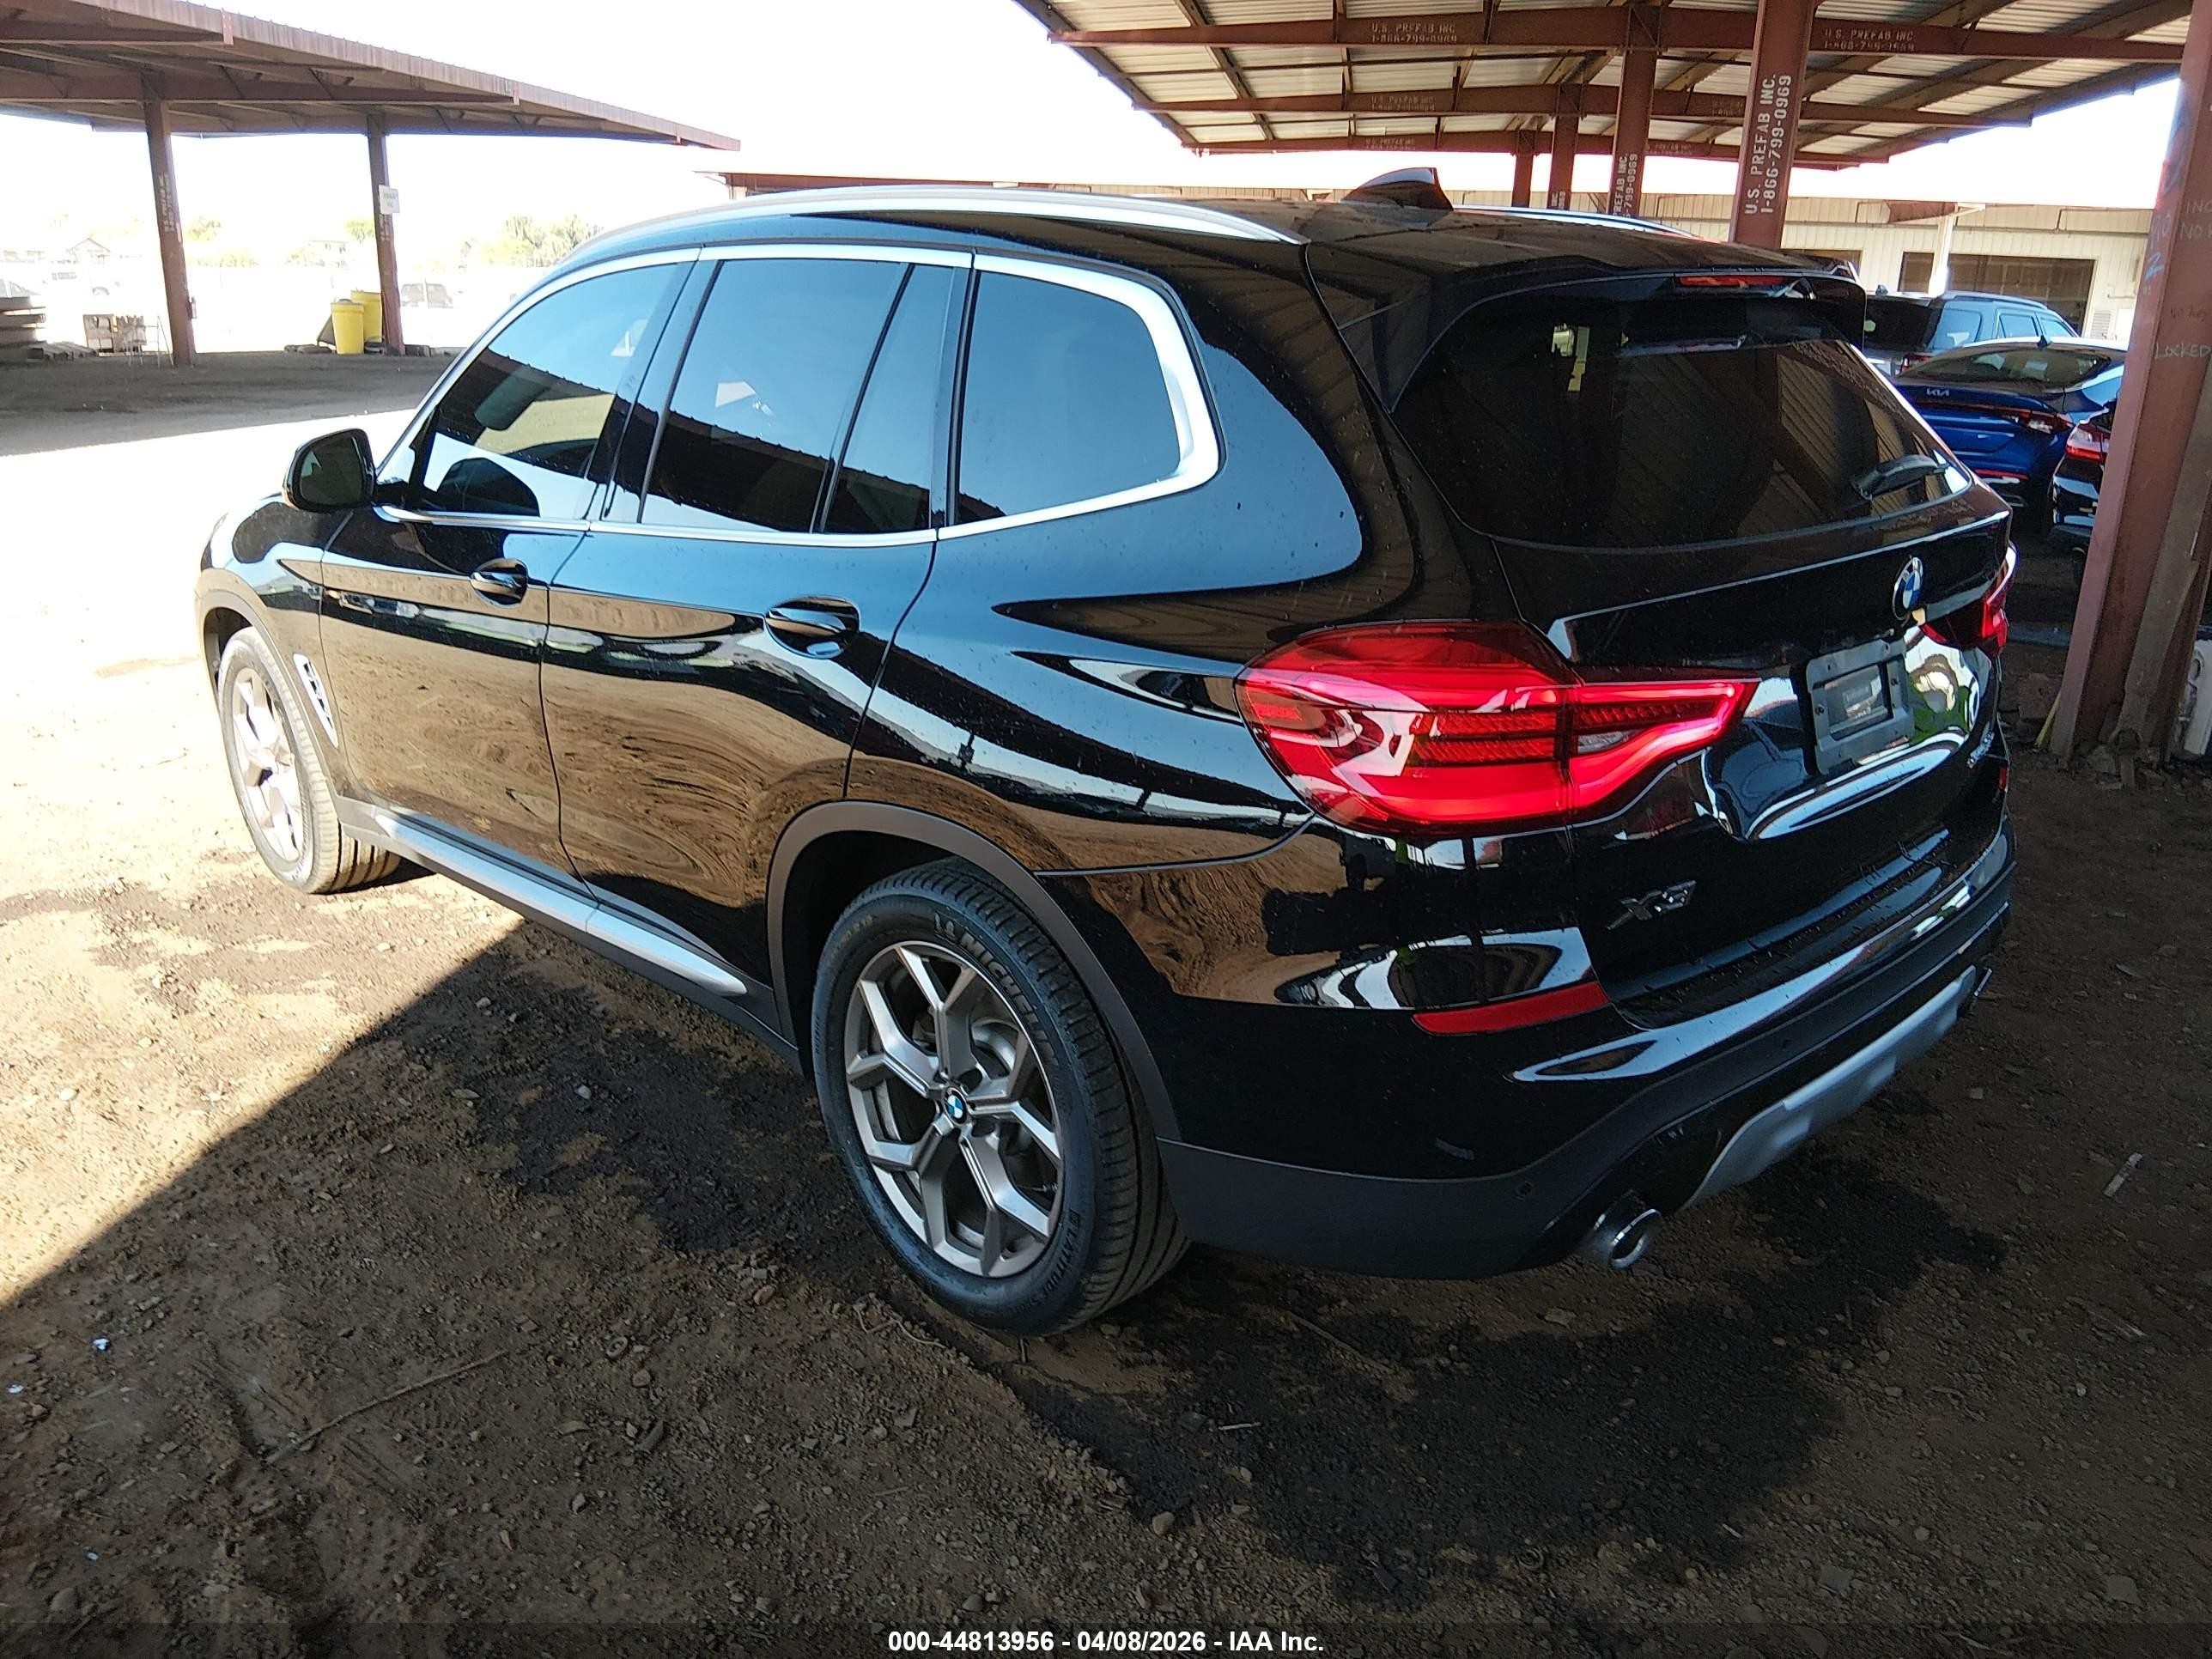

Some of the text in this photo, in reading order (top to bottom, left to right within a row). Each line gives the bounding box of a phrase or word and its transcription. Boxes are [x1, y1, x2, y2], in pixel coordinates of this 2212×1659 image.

[1745, 74, 1777, 215] U.S. PREFAB INC.
[1760, 75, 1792, 214] 1-866-799-0969
[1607, 880, 1697, 930] X3
[959, 931, 1060, 1066] MICHELIN
